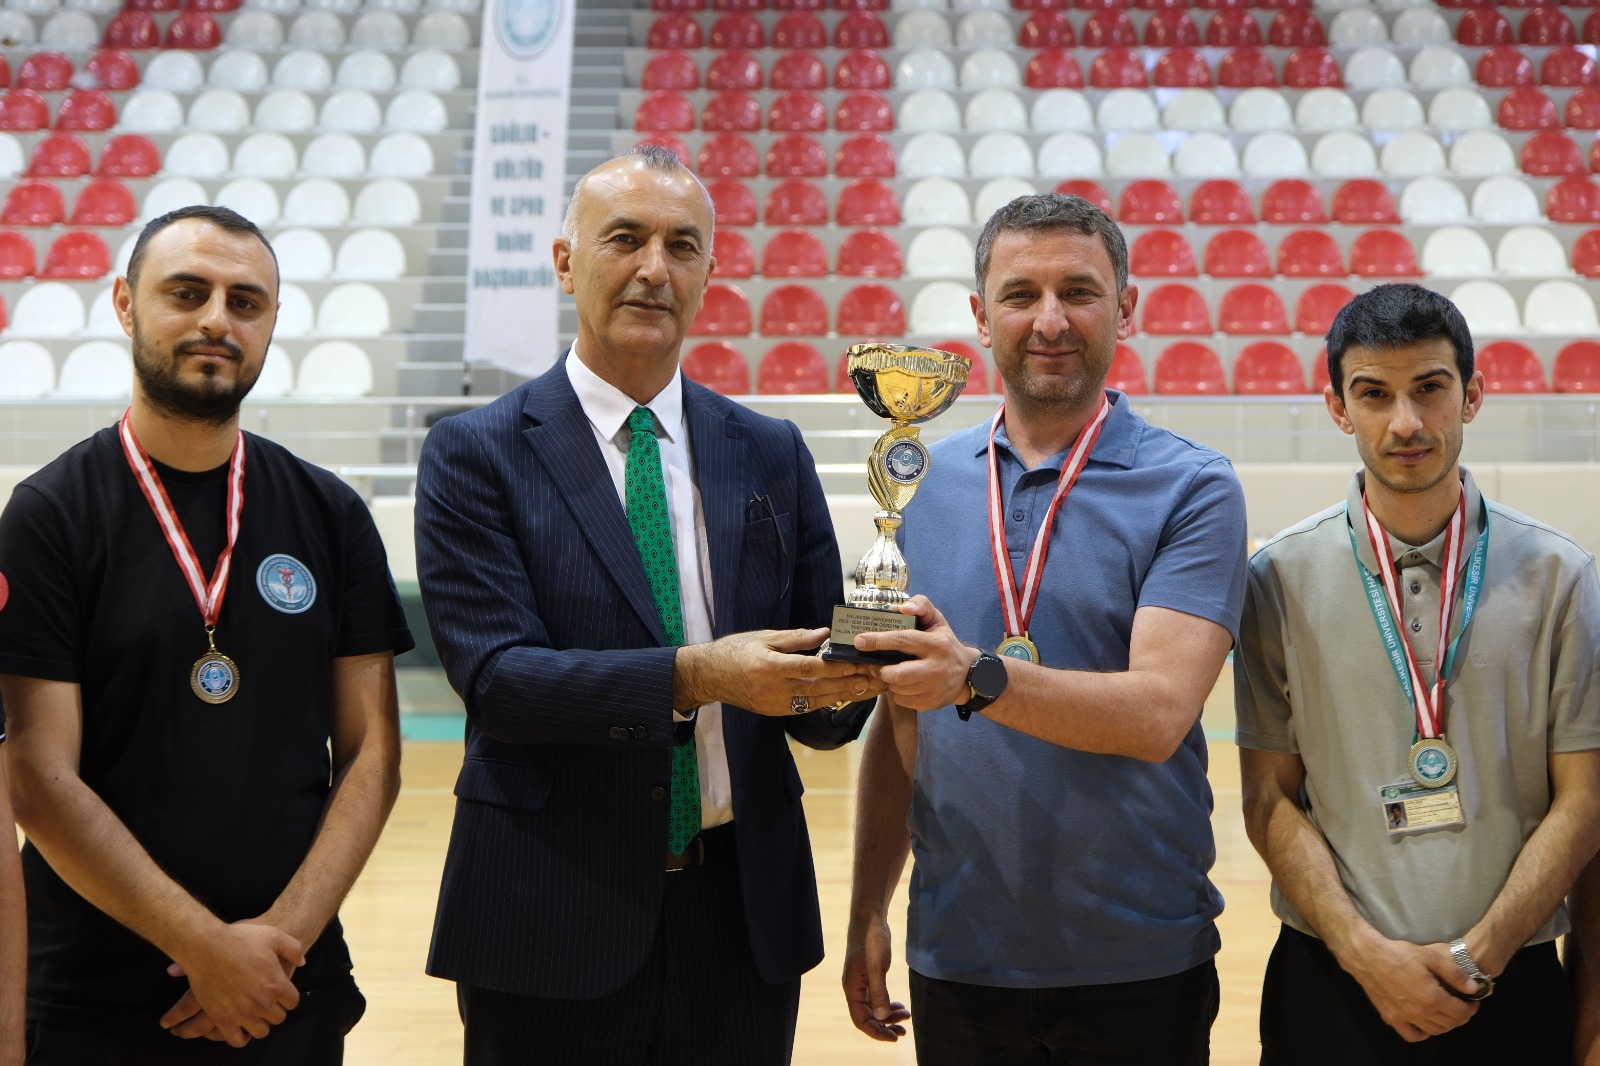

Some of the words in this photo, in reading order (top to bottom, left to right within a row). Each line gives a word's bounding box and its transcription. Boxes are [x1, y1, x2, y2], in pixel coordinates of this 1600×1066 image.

[1470, 541, 1484, 585] BALIKESİR
[1369, 589, 1397, 649] ÜNİVERSİTESİ
[1392, 649, 1412, 698] BALIKESİR
